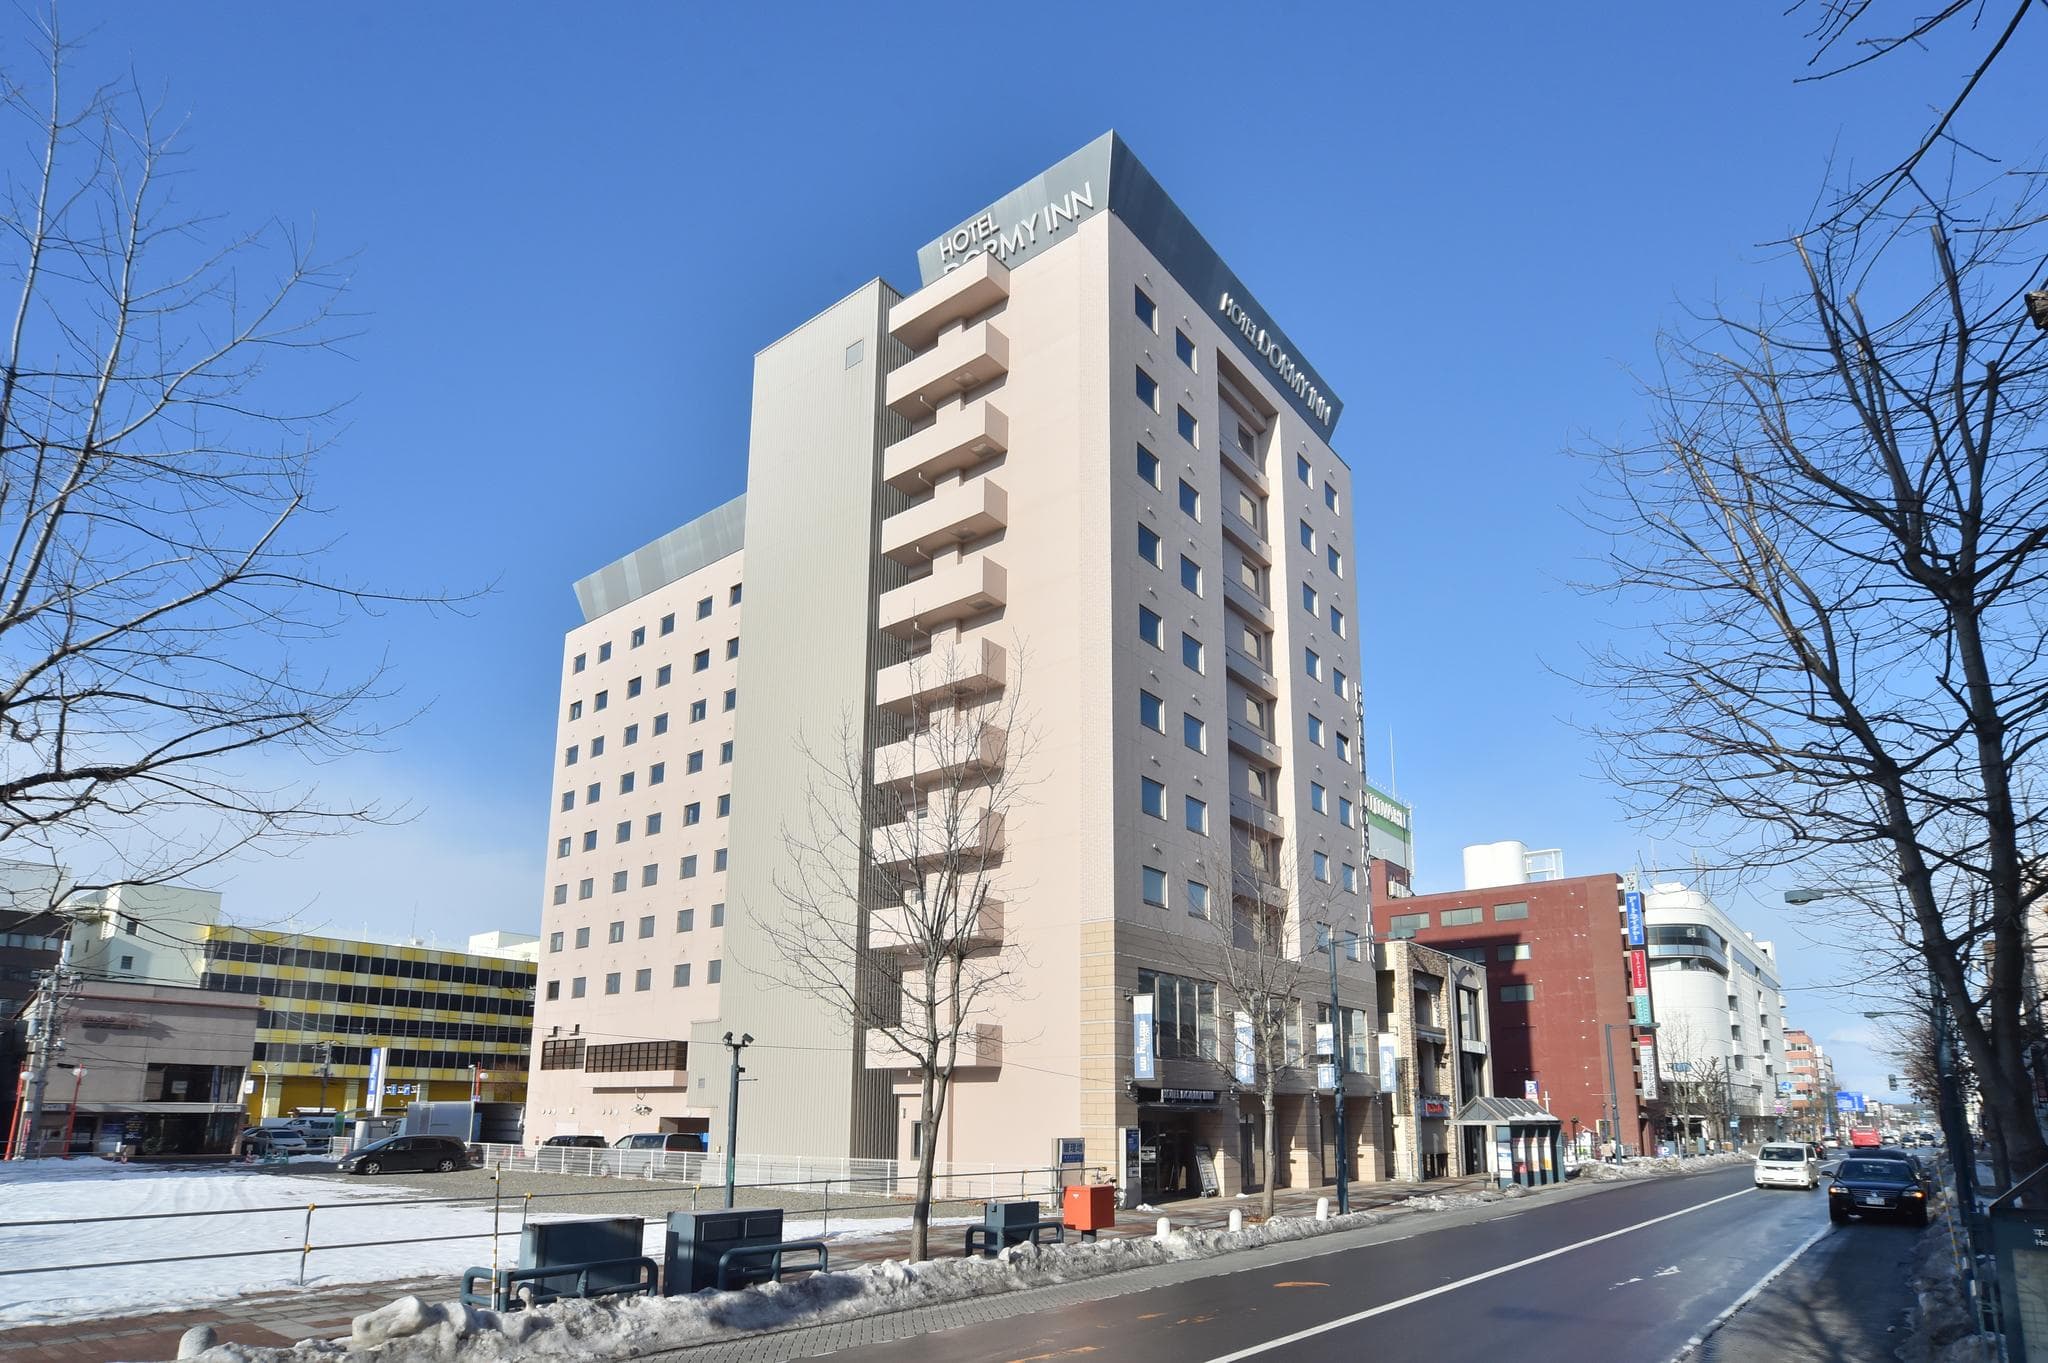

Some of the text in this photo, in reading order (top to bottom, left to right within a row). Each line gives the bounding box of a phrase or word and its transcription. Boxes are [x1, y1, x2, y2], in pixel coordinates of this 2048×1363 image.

[940, 212, 1000, 262] HOTEL
[944, 181, 1094, 274] RMY INN
[1219, 292, 1257, 347] HOTEL
[1257, 329, 1311, 399] DORMY
